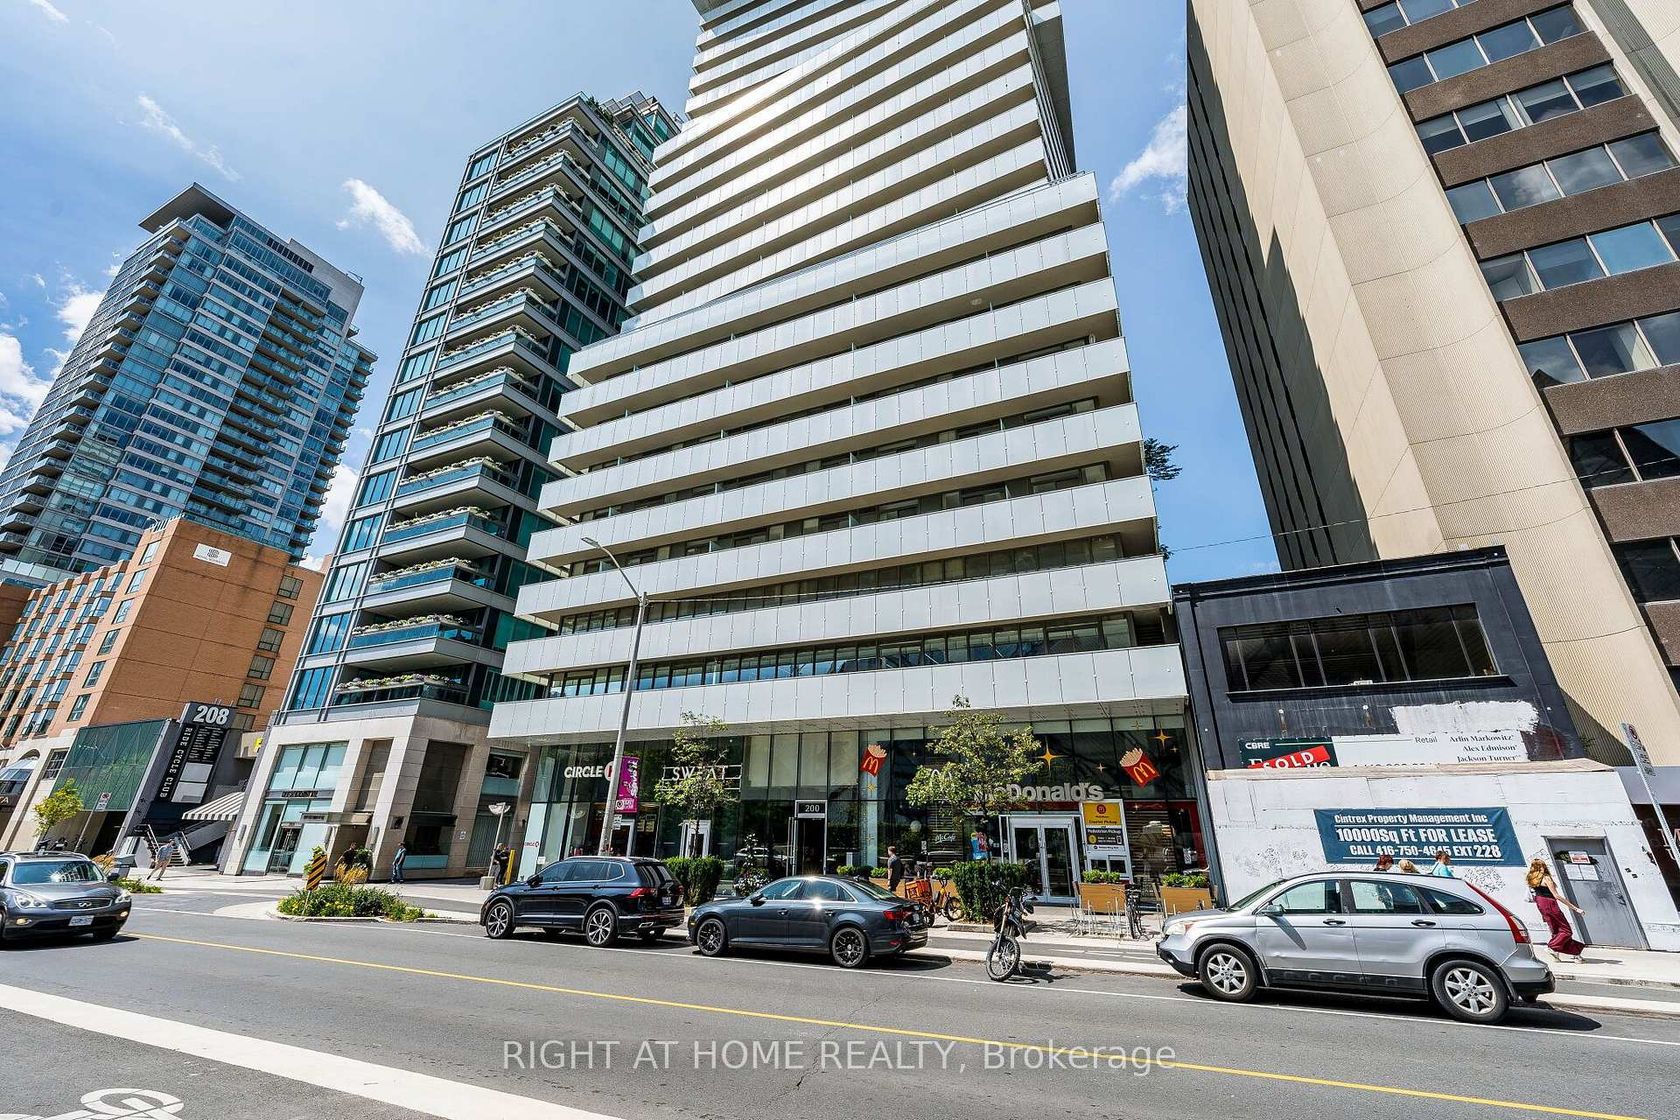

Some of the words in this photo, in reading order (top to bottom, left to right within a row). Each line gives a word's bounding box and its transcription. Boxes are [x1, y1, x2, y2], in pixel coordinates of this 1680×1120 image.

[193, 705, 229, 725] 208
[180, 727, 193, 746] RIDE
[169, 750, 184, 773] CYCLE
[564, 766, 604, 778] CIRCLE
[160, 777, 174, 798] CLUB
[1334, 814, 1367, 823] Cintrex
[1367, 814, 1407, 824] Property
[1409, 814, 1471, 824] Management
[1471, 814, 1488, 822] Inc
[1336, 828, 1400, 844] 10000Sq
[1400, 828, 1418, 842] Ft
[1419, 828, 1449, 842] FOR
[1450, 828, 1497, 842] LEASE
[1349, 845, 1375, 855] CALL
[1452, 845, 1473, 856] EXT
[1473, 845, 1502, 858] 228
